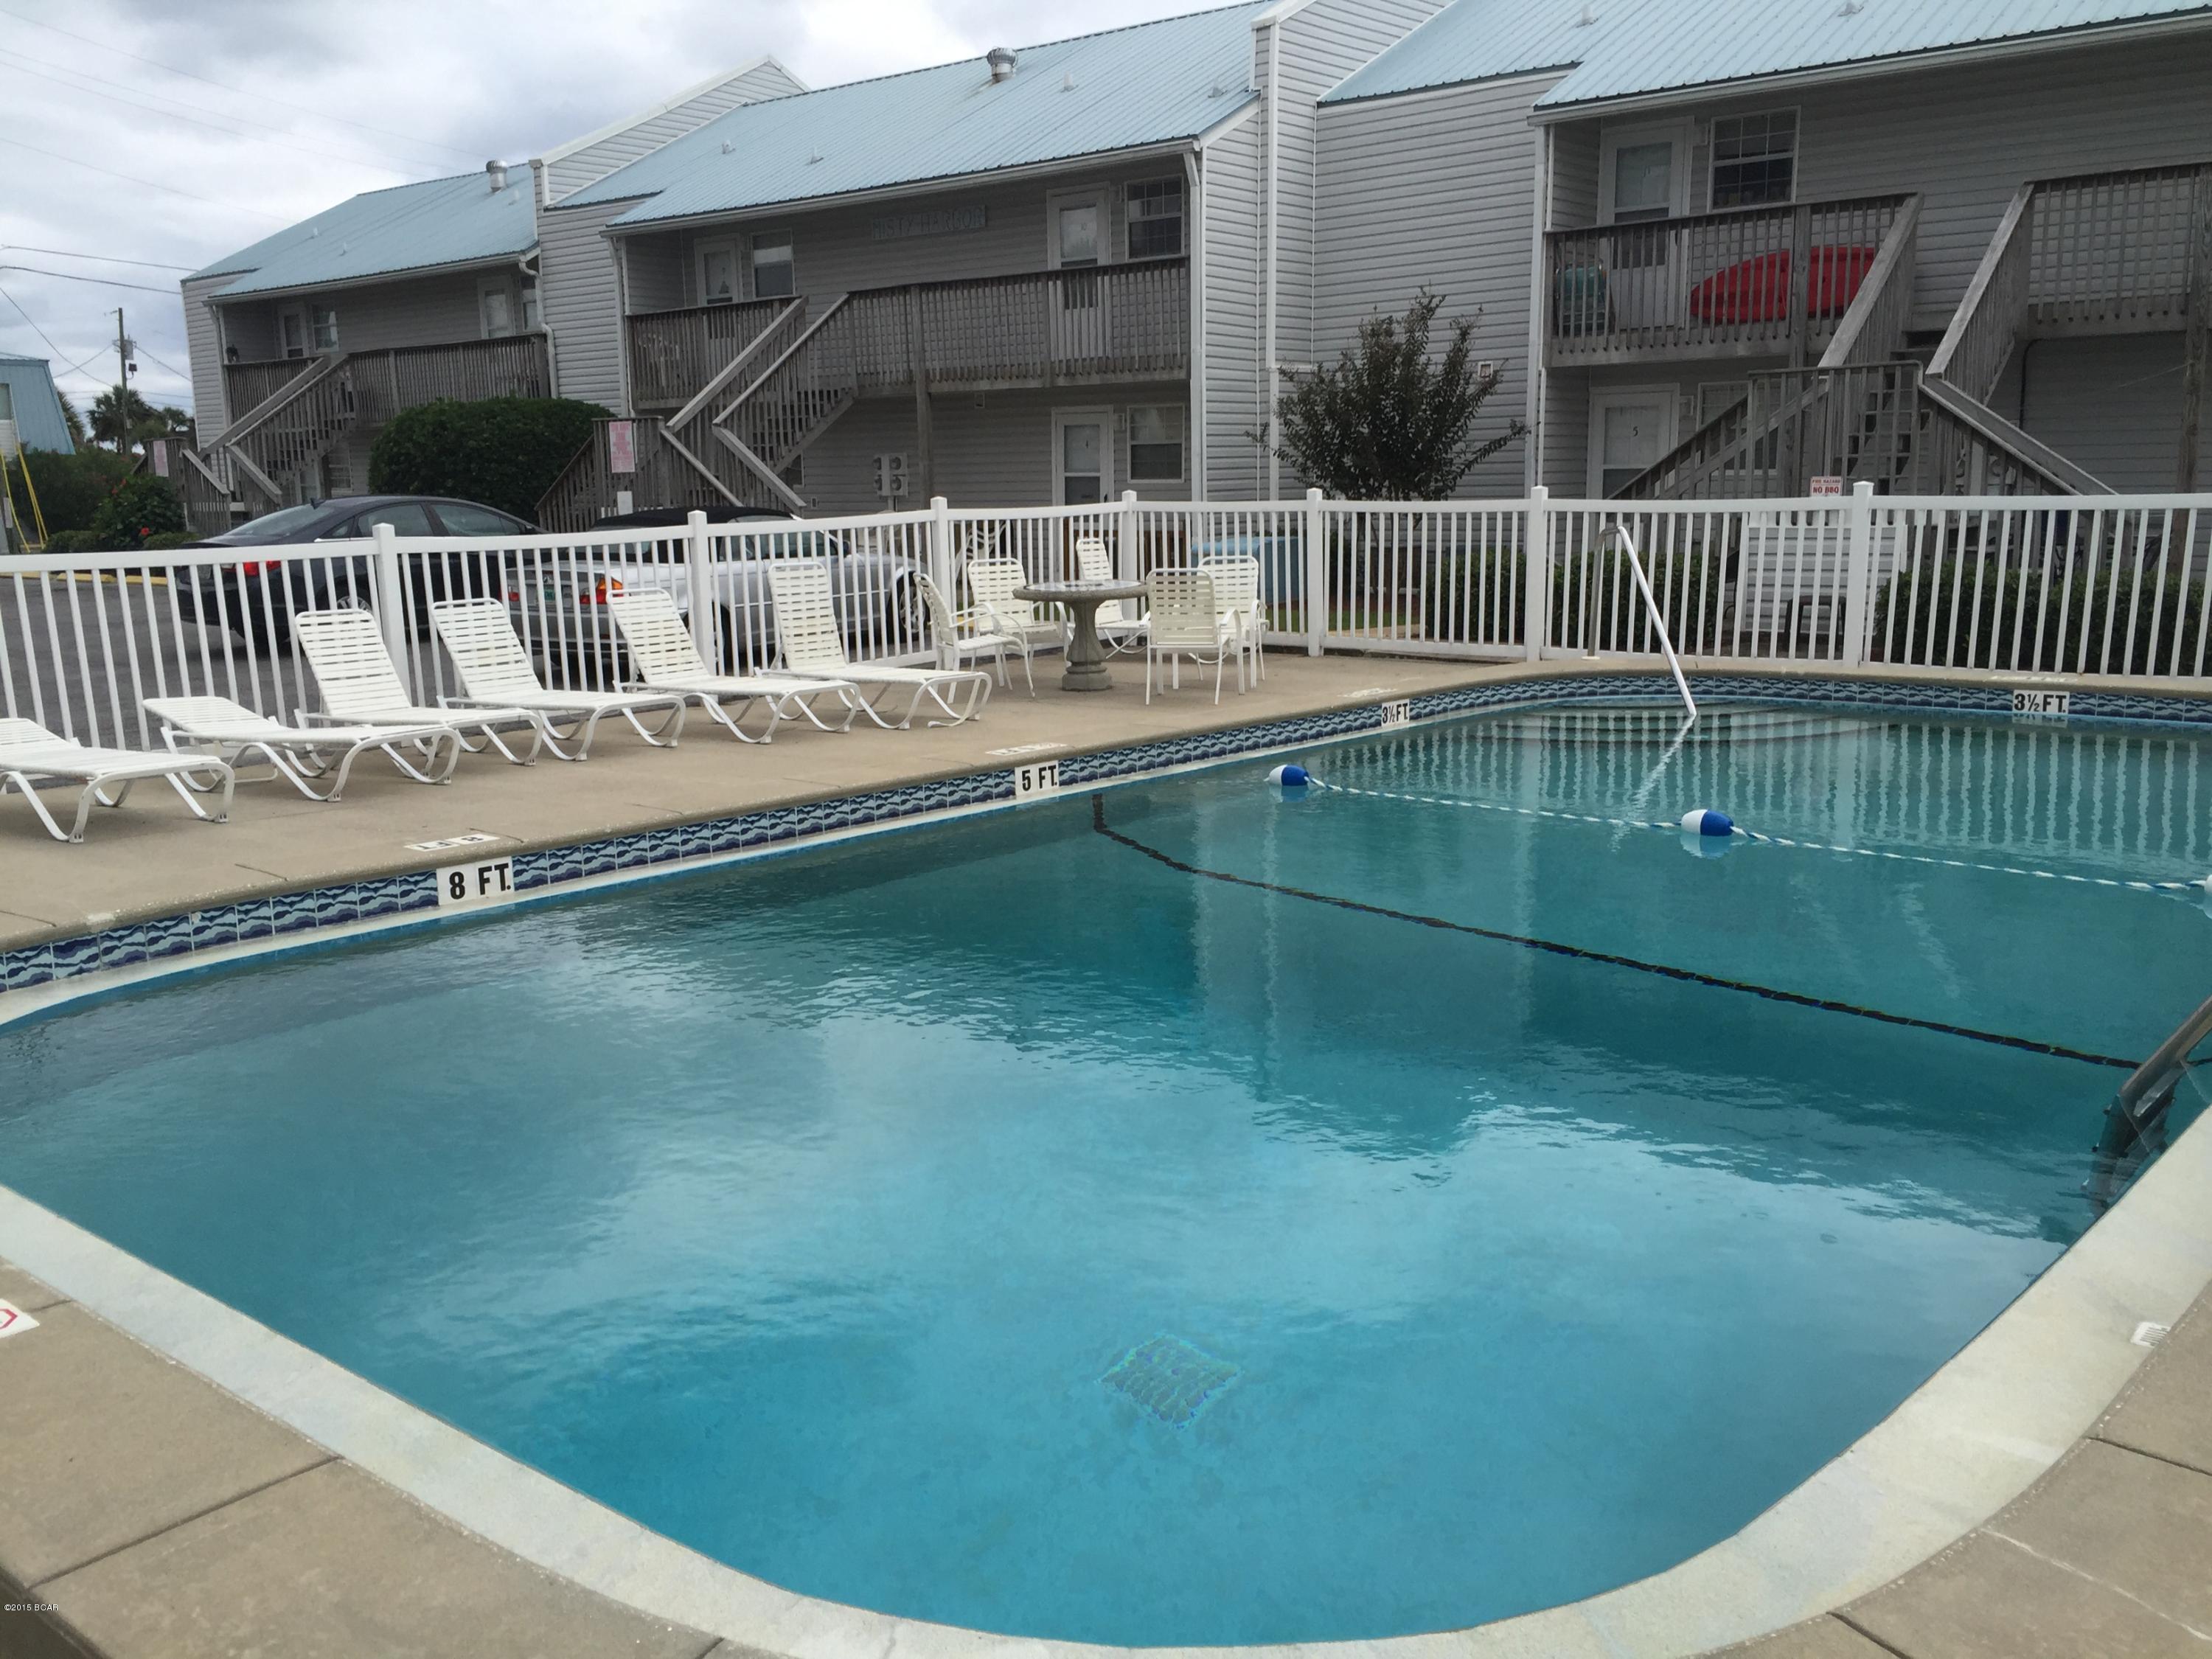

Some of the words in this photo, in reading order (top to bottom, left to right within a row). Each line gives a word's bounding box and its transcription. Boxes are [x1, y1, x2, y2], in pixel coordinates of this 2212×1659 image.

[1633, 425, 1638, 437] 5
[1397, 703, 1408, 722] FT.
[2042, 694, 2067, 713] FT.
[1021, 769, 1032, 791] 5
[1038, 765, 1057, 789] FT.
[449, 871, 465, 900] 8
[478, 863, 511, 895] FT.
